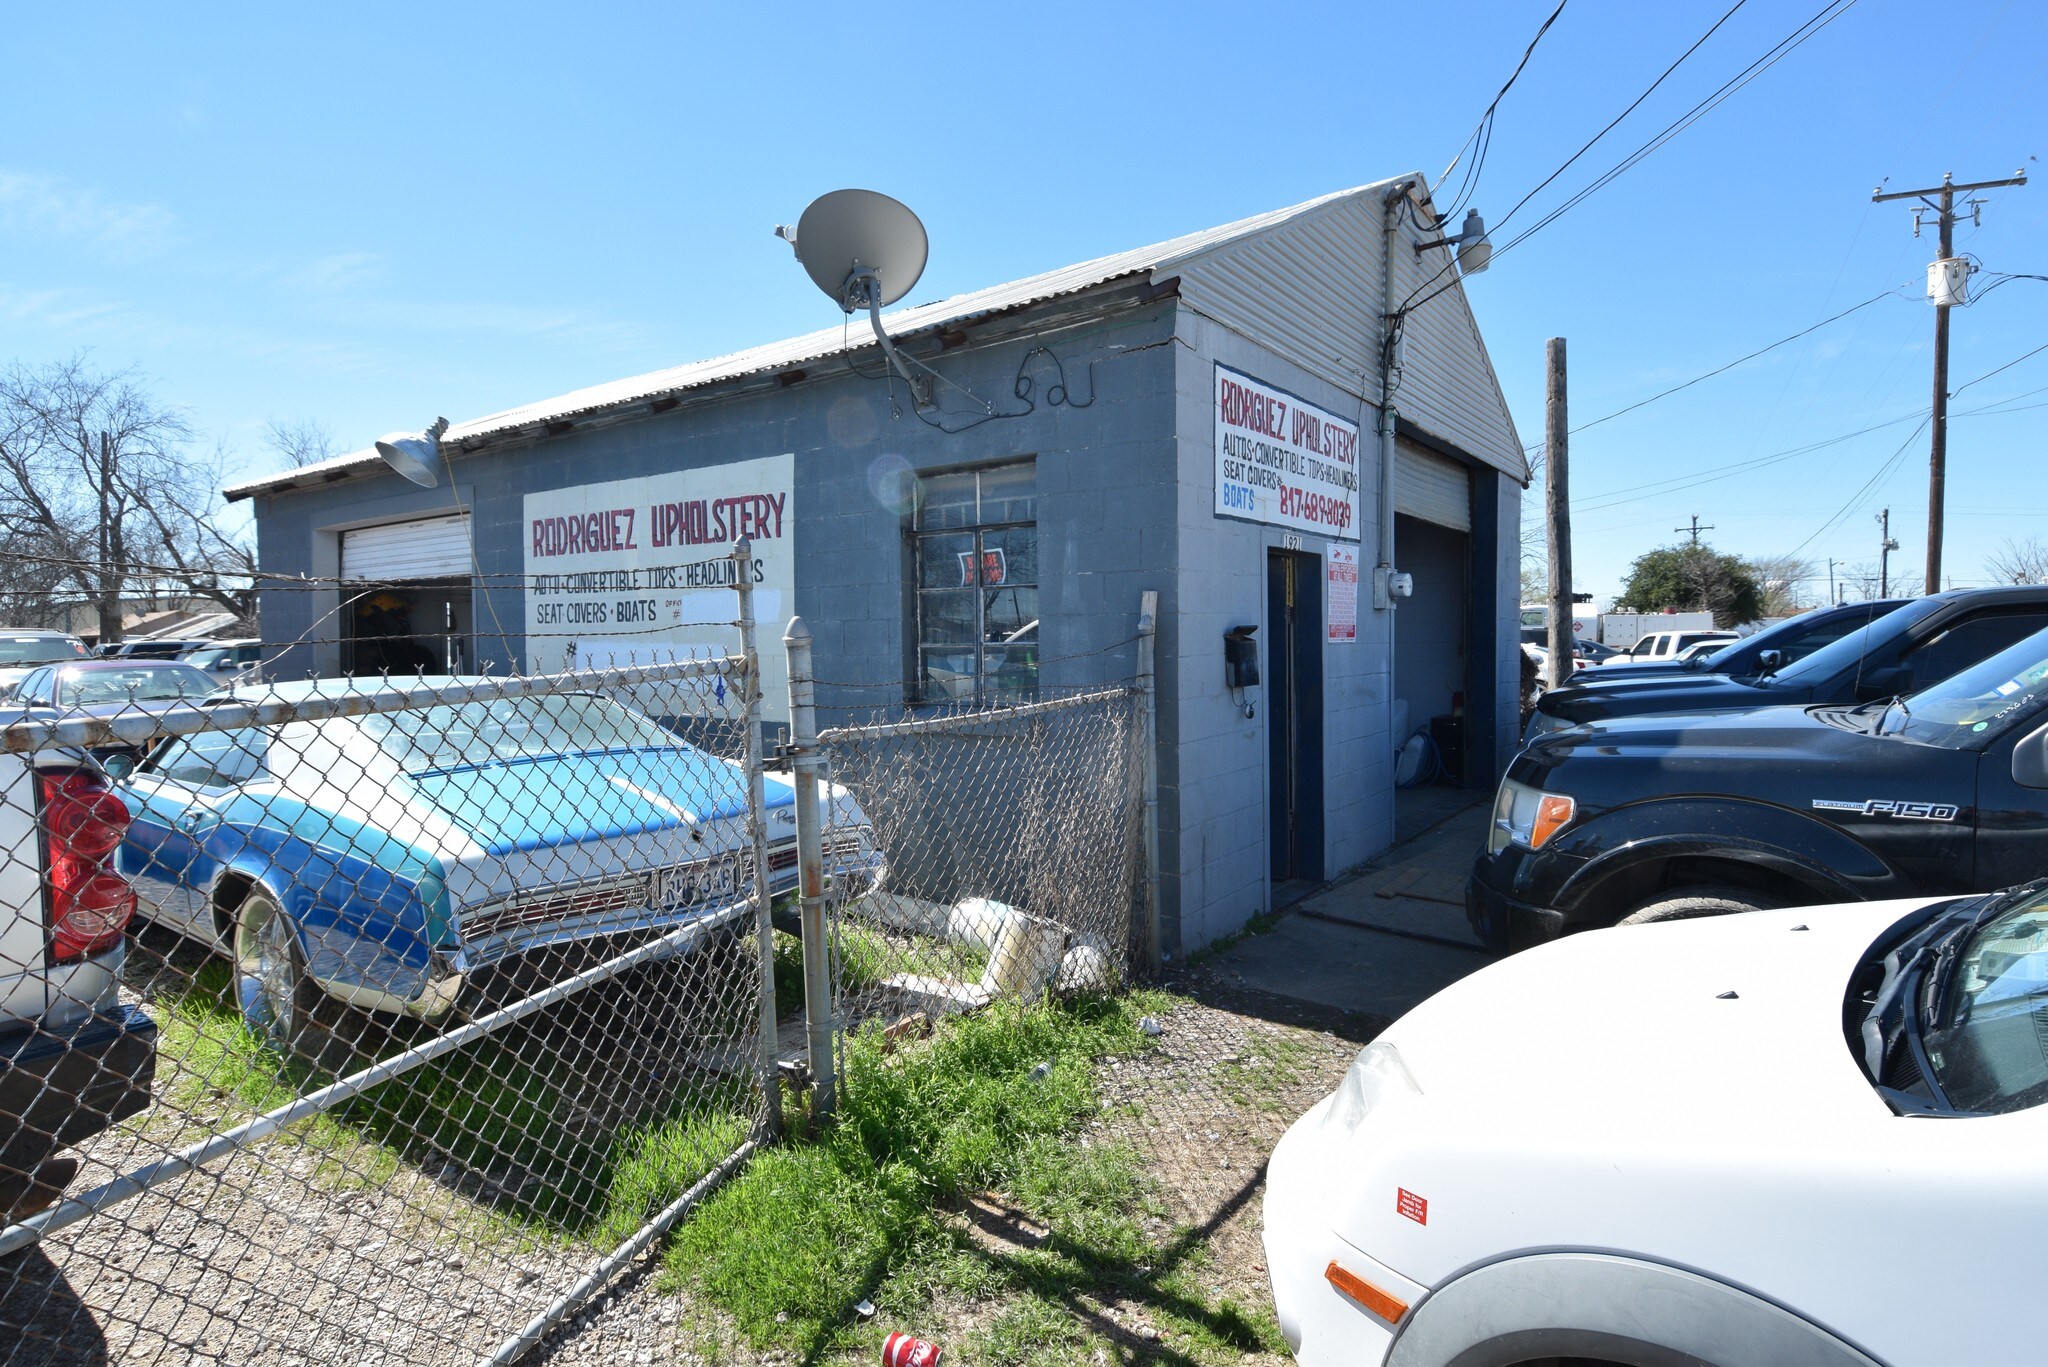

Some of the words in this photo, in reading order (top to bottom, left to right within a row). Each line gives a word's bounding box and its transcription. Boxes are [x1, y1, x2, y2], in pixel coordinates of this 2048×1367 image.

[1221, 378, 1287, 441] RODRIGUEZ
[1292, 407, 1356, 465] UPHOLSTERY
[1223, 459, 1245, 482] SEAT
[1247, 465, 1276, 490] COVERS
[1223, 482, 1255, 511] BOATS
[532, 508, 638, 558] RODRIGUEZ
[651, 492, 786, 548] UPHOLSTERY
[1285, 534, 1301, 550] 1921
[686, 558, 764, 586] HEADLINS
[537, 603, 563, 624] SEAT
[566, 602, 607, 624] COVERS
[616, 599, 657, 623] BOATS
[1815, 801, 1864, 810] PLATINUM
[1862, 799, 1959, 821] F-150
